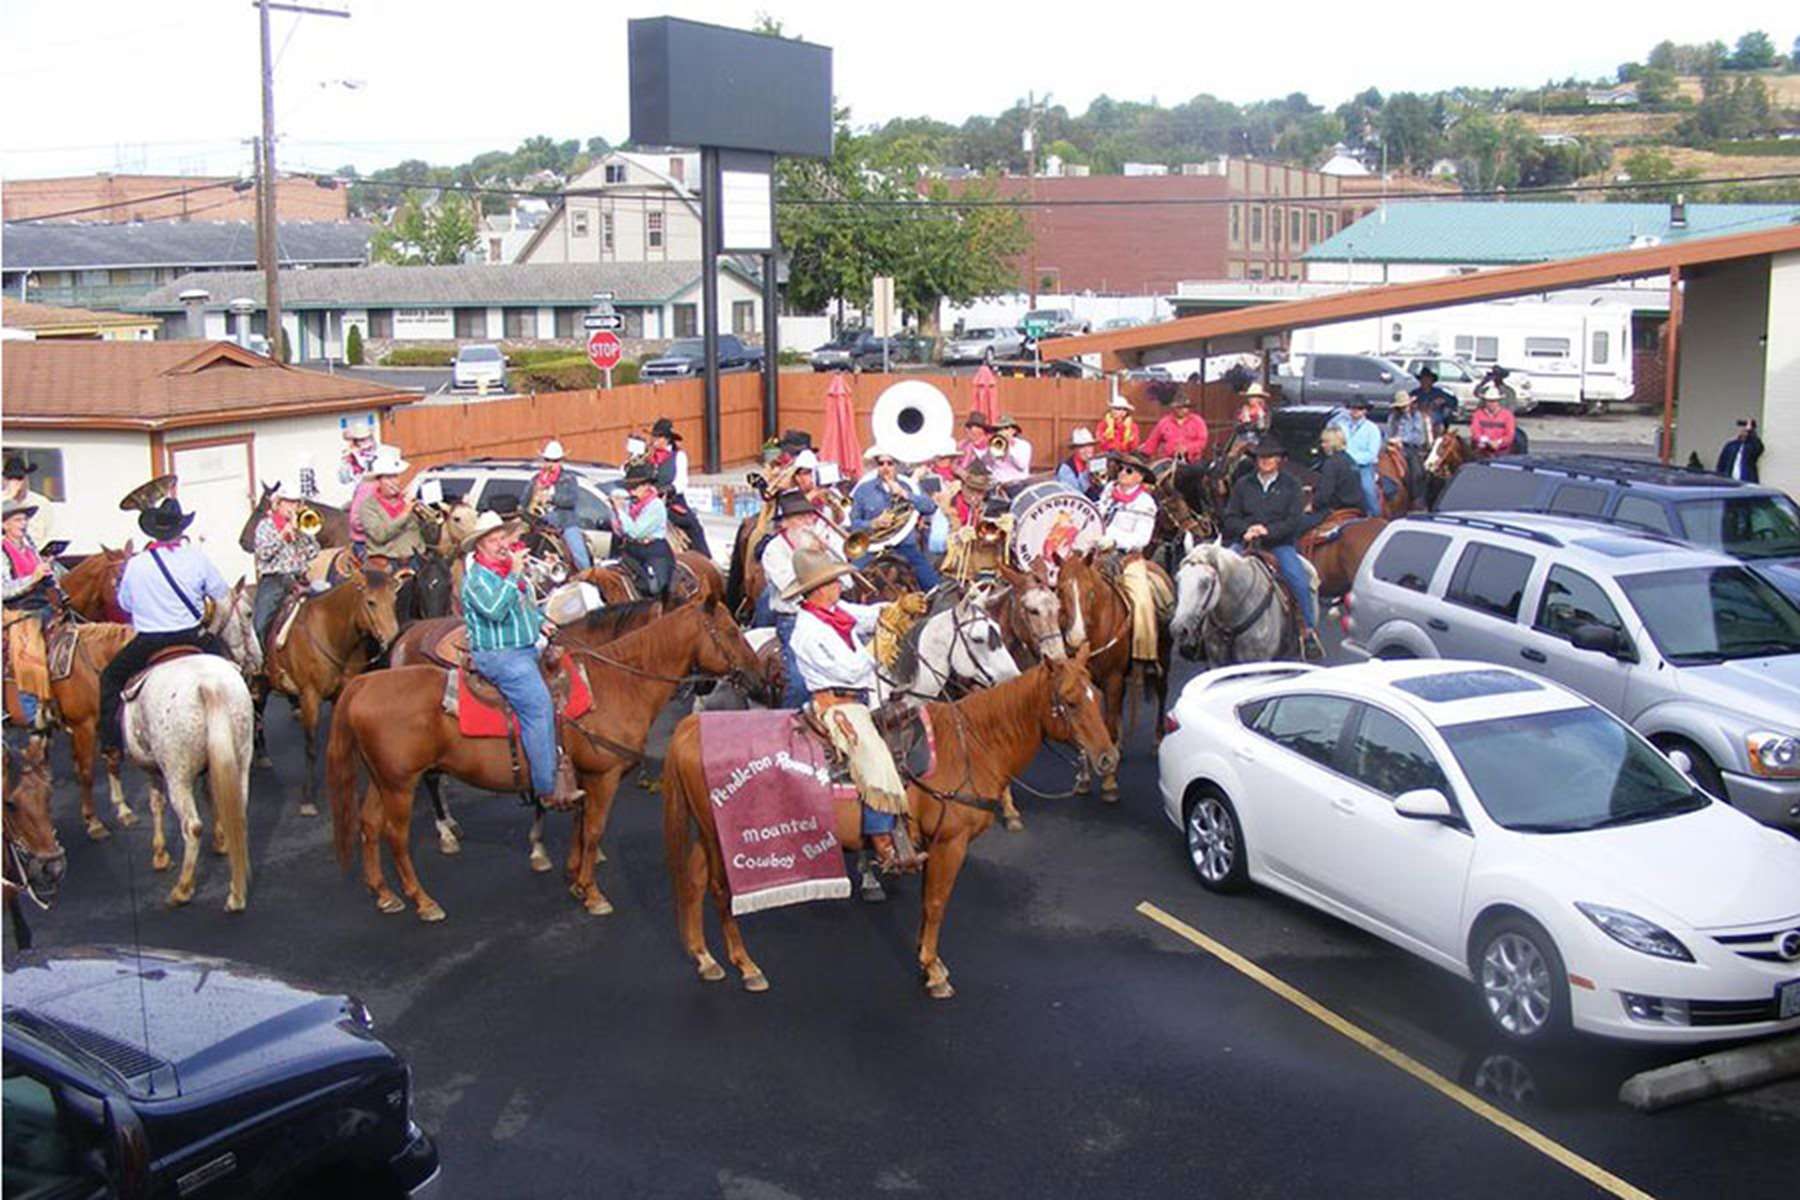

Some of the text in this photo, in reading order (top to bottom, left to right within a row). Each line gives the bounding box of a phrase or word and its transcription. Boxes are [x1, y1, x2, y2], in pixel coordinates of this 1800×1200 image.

[591, 342, 618, 358] STOP
[710, 755, 773, 808] Pendleton
[733, 831, 838, 869] Cowboy Band
